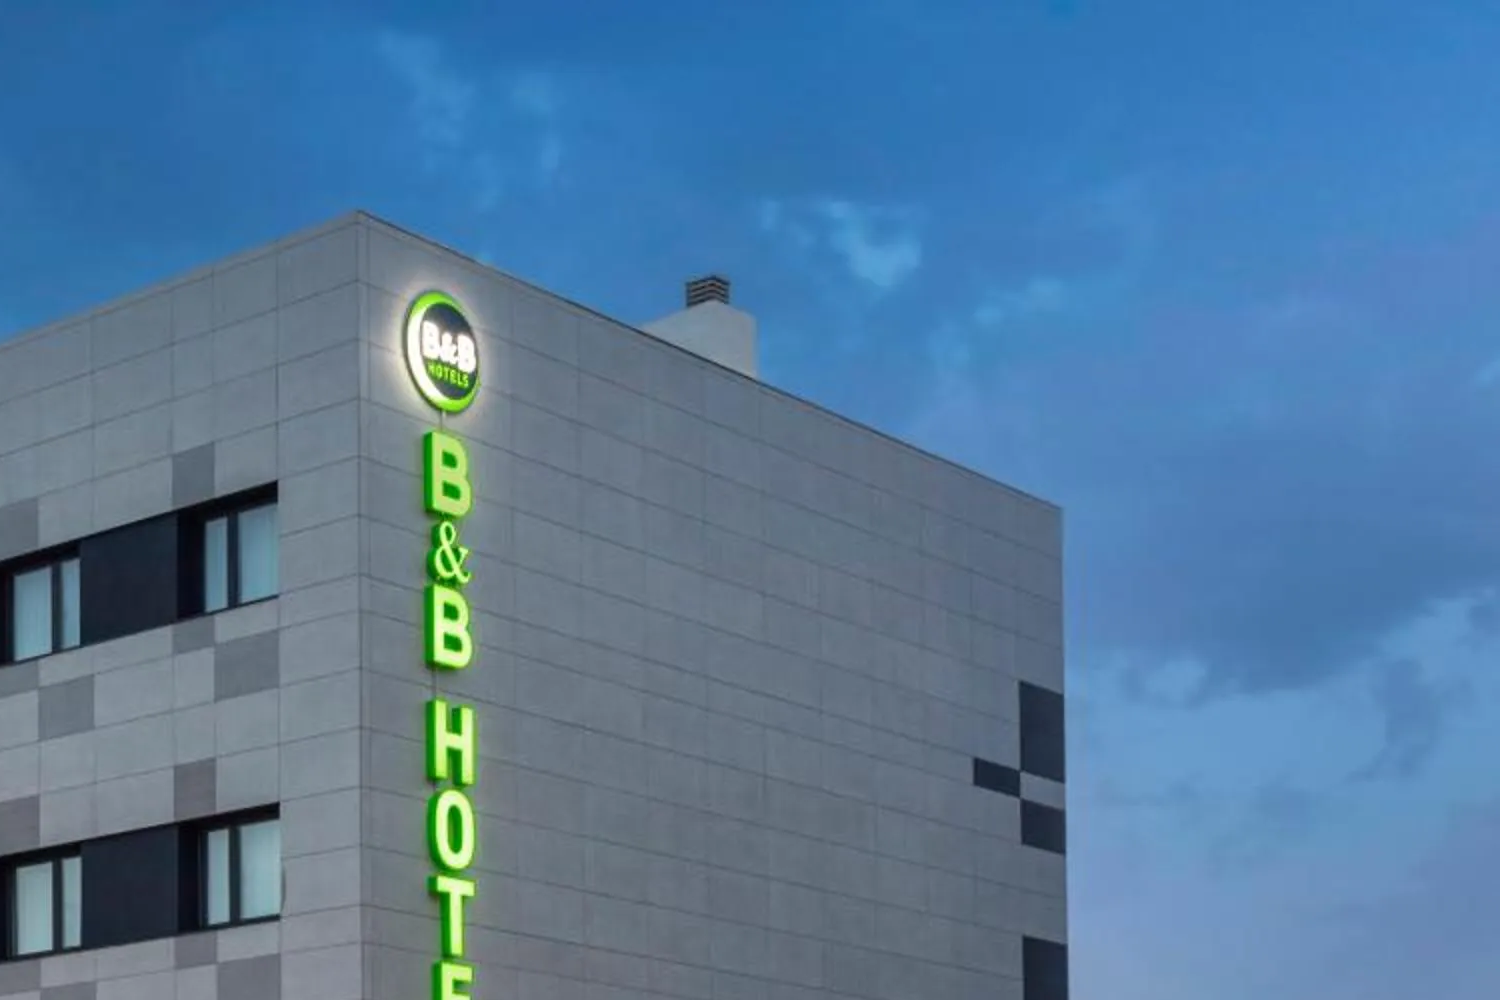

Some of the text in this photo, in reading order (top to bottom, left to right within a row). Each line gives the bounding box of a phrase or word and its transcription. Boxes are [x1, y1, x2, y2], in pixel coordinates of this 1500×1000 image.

[422, 320, 477, 373] B&B
[427, 361, 469, 389] HOTELS
[424, 431, 473, 670] B&B
